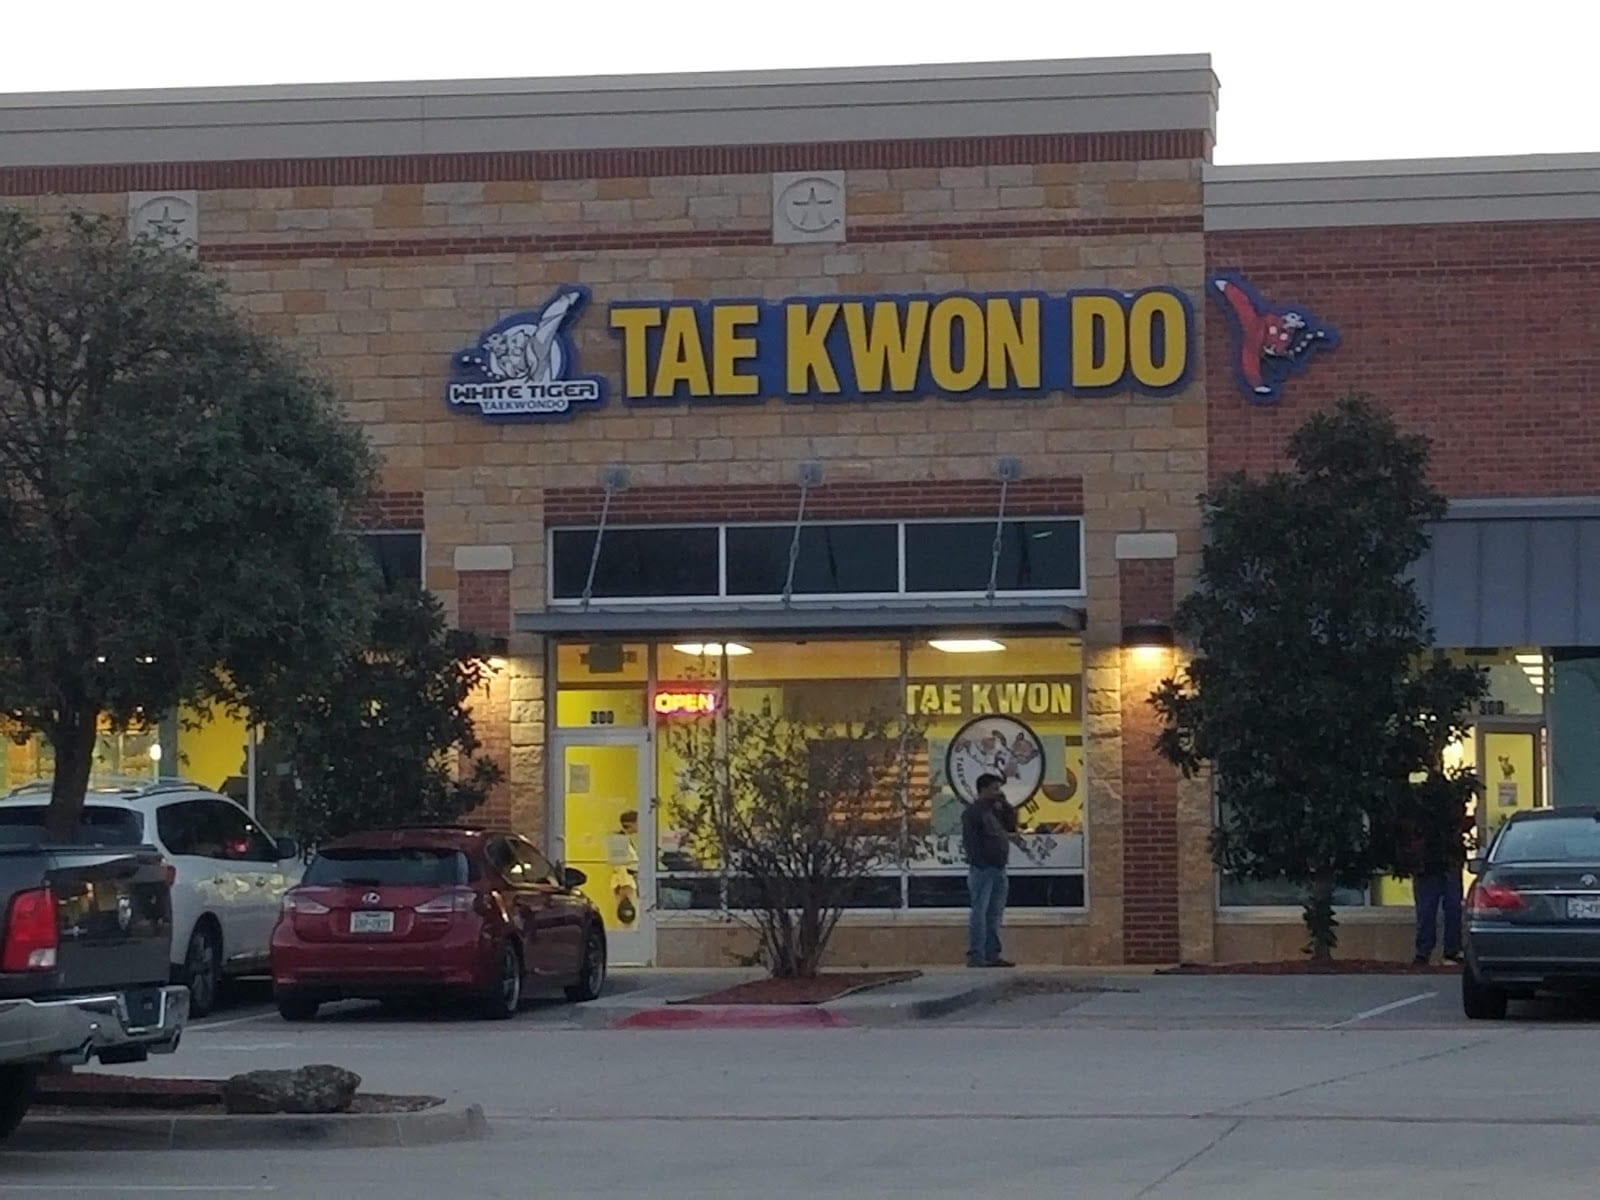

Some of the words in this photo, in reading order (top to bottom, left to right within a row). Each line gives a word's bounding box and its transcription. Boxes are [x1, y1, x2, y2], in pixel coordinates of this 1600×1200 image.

[610, 304, 759, 398] TAE
[787, 297, 1040, 394] KWON
[1072, 291, 1187, 388] DO
[453, 386, 522, 400] WHITE
[528, 383, 594, 397] TIGER
[482, 399, 566, 411] TAEKWONDO
[655, 692, 715, 713] OPEN
[906, 683, 962, 715] TAE
[972, 682, 1072, 714] KWON
